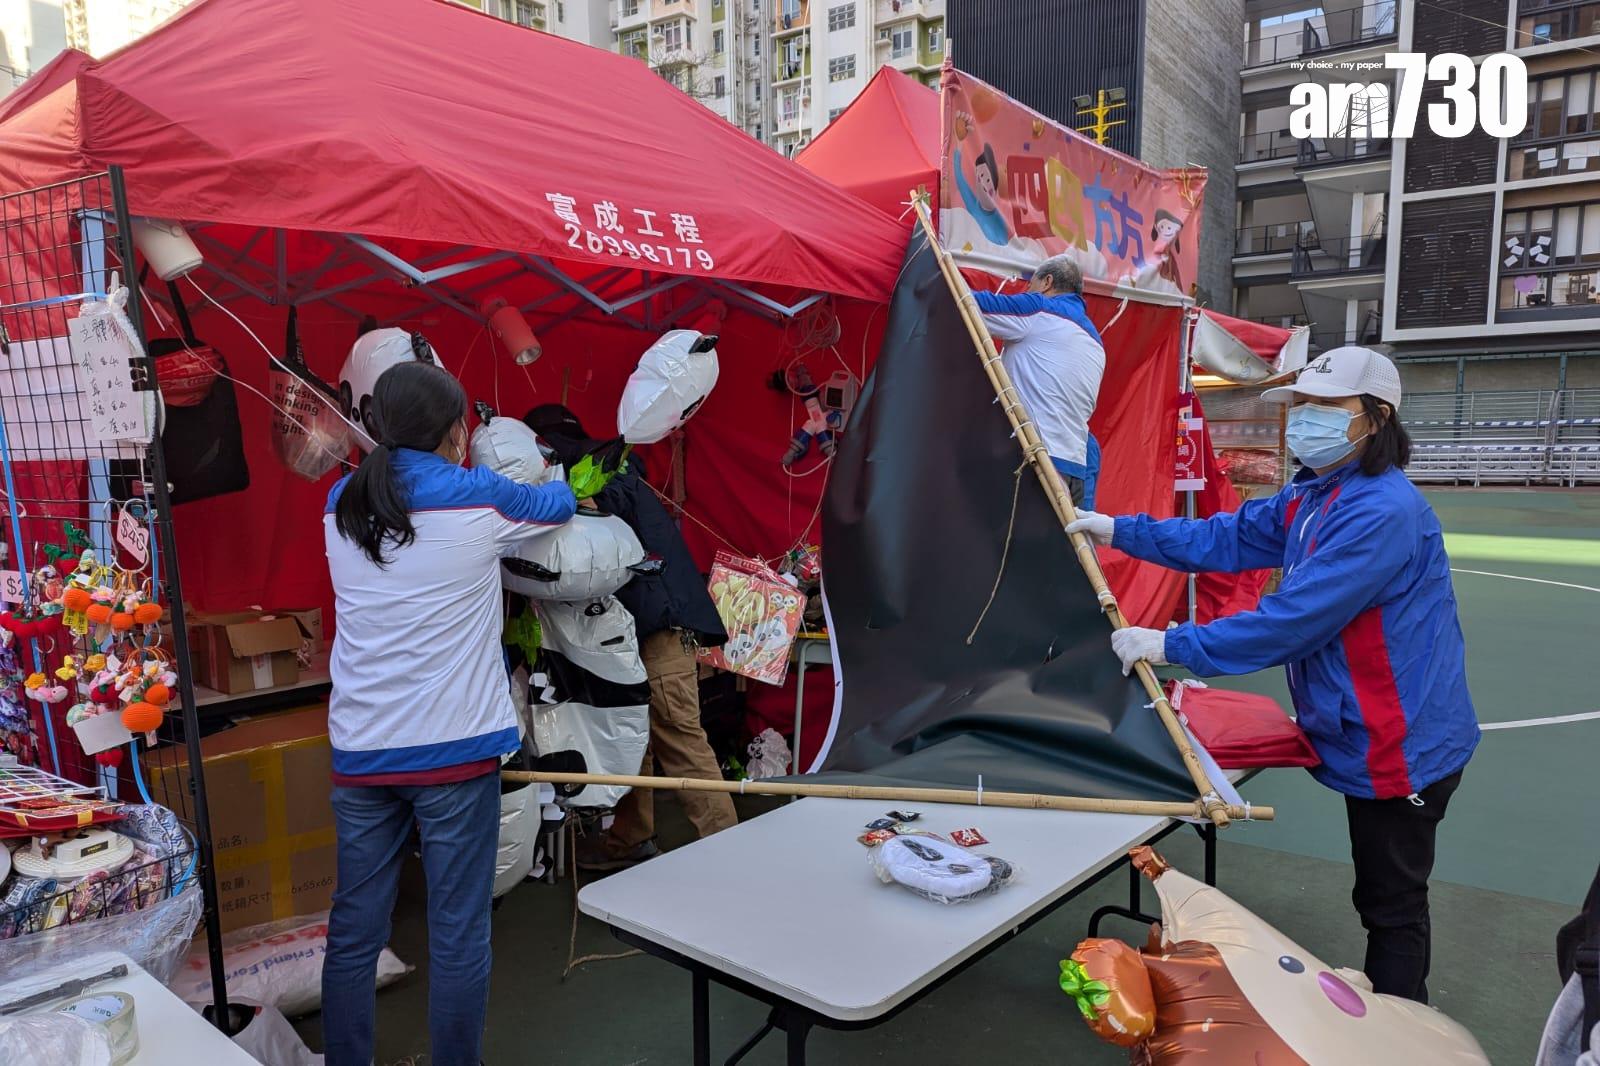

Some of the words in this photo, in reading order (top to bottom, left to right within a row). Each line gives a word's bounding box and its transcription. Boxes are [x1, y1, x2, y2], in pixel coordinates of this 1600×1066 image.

[545, 192, 704, 244] 富成工程
[564, 223, 714, 271] 26998779
[120, 517, 146, 553] $40
